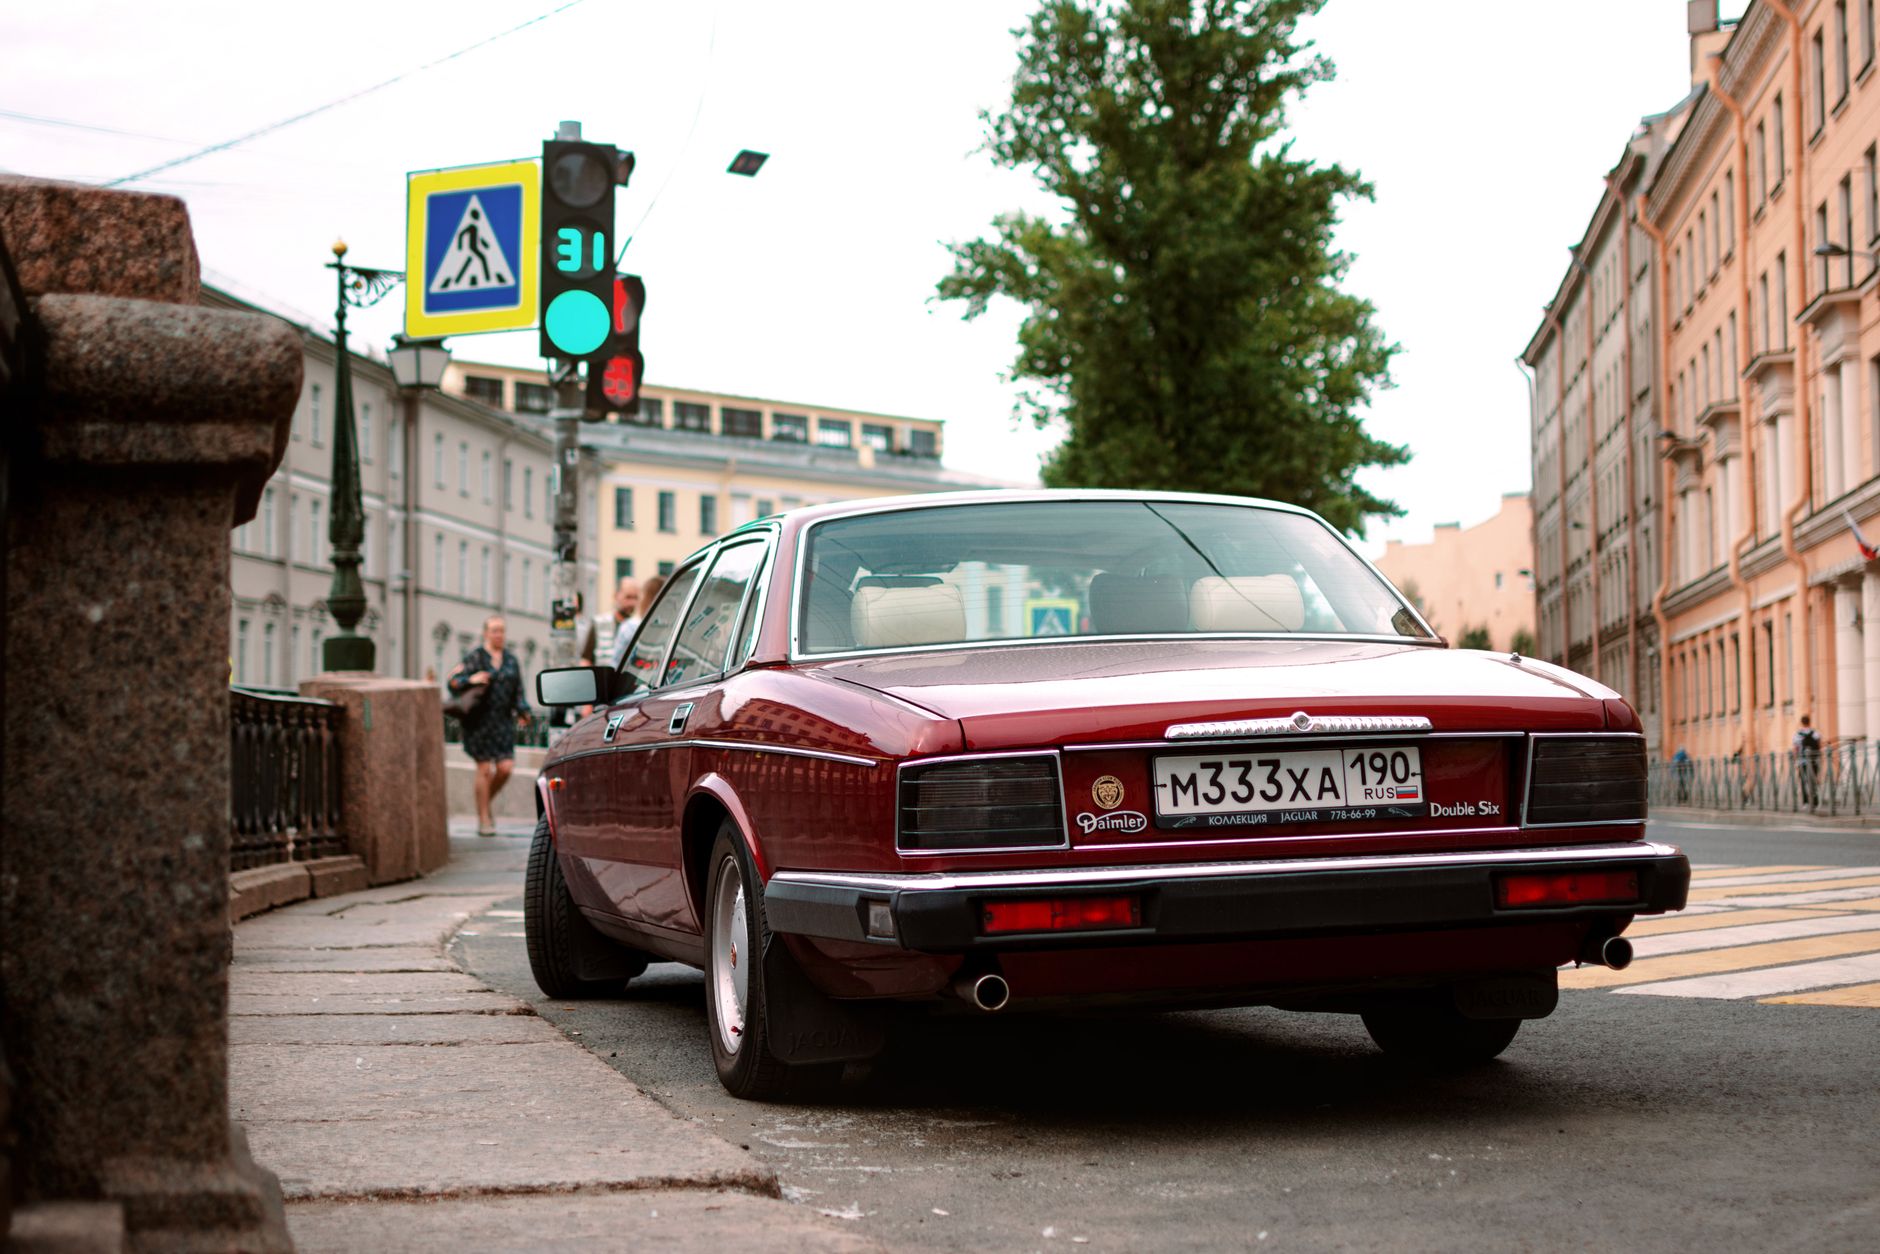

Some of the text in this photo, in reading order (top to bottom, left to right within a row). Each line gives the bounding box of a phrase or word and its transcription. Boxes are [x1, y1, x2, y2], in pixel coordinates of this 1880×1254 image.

[557, 228, 604, 271] 31
[1171, 760, 1341, 807] М333ХА
[1350, 751, 1410, 785] 190
[1364, 786, 1394, 800] RUS
[1208, 808, 1376, 826] КОЛЛЕКЦИЯ JAGUAR 778-66-99
[1430, 801, 1500, 818] Double Six
[1076, 811, 1148, 834] Daimler
